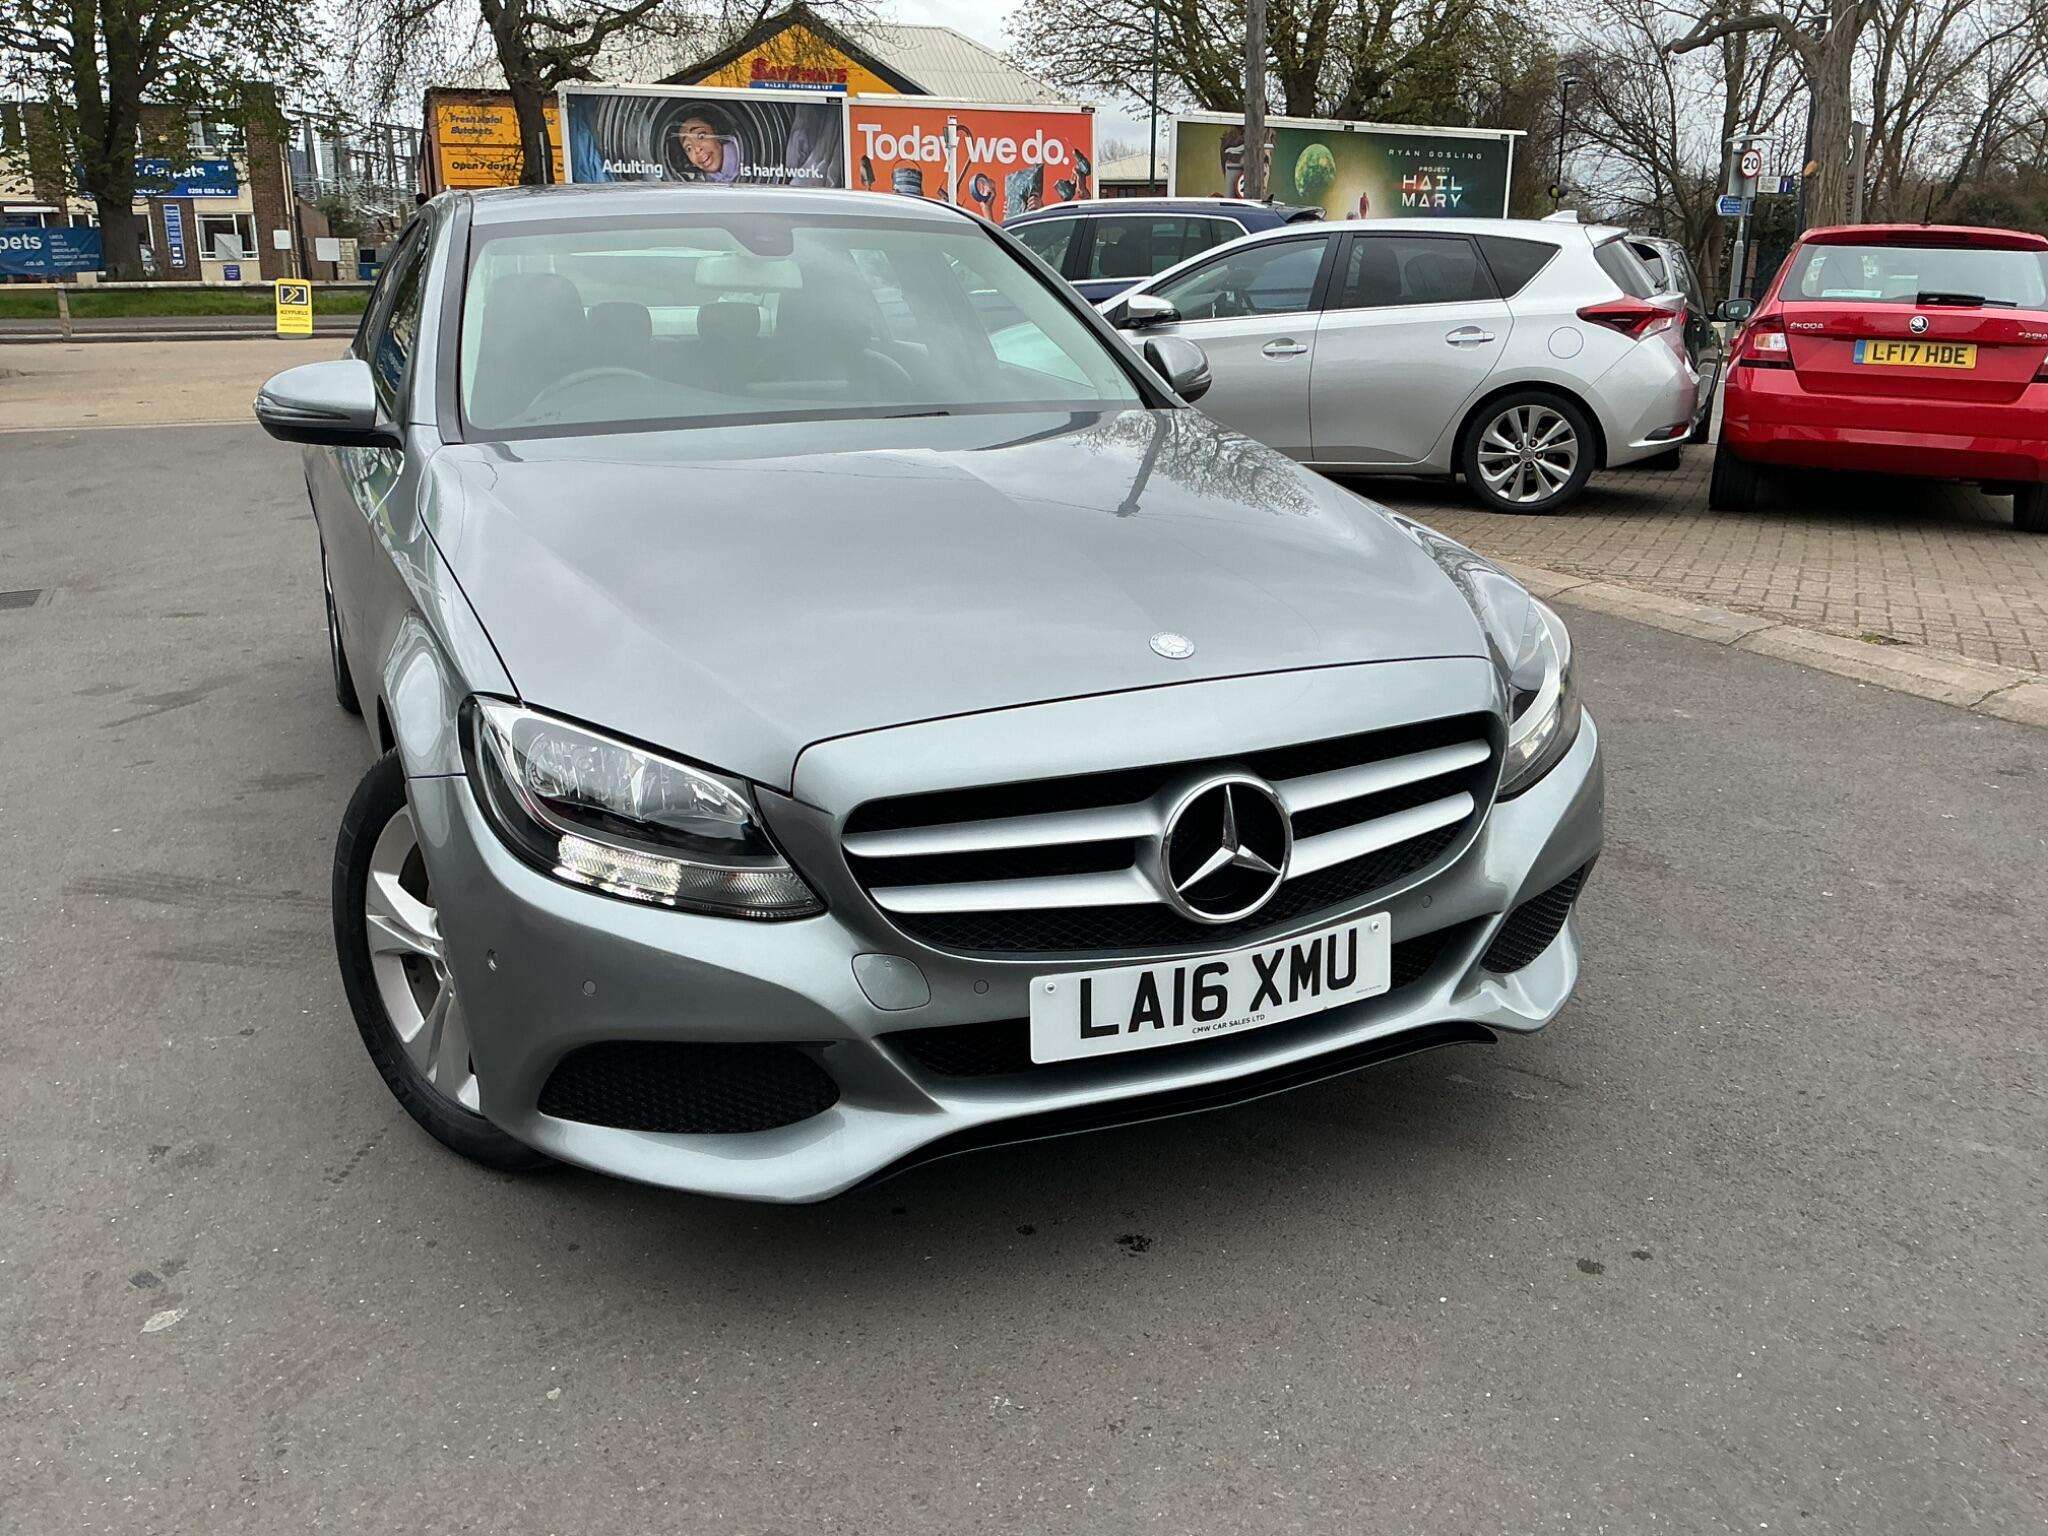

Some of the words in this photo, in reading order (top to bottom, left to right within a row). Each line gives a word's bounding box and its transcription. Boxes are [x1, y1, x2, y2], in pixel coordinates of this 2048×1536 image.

[857, 124, 960, 173] Today
[965, 136, 1017, 164] we
[1021, 130, 1070, 165] do.
[1388, 149, 1421, 157] RYAN
[1428, 150, 1482, 160] GOSLING
[452, 161, 478, 171] Open
[479, 162, 487, 170] 7
[602, 159, 663, 179] Adulting
[740, 163, 752, 177] is
[753, 163, 784, 178] hard
[785, 164, 824, 179] work.
[1743, 157, 1759, 170] 20
[1402, 174, 1463, 191] HAIL
[1401, 192, 1462, 208] MARY
[1872, 343, 1921, 362] LF17
[1925, 345, 1968, 365] HDE
[1079, 960, 1229, 1040] LA16
[1250, 927, 1358, 1013] XMU
[1192, 1025, 1211, 1034] CMW
[1212, 1021, 1227, 1031] CAR
[1228, 1017, 1251, 1027] SALES
[1251, 1014, 1266, 1022] LTD
